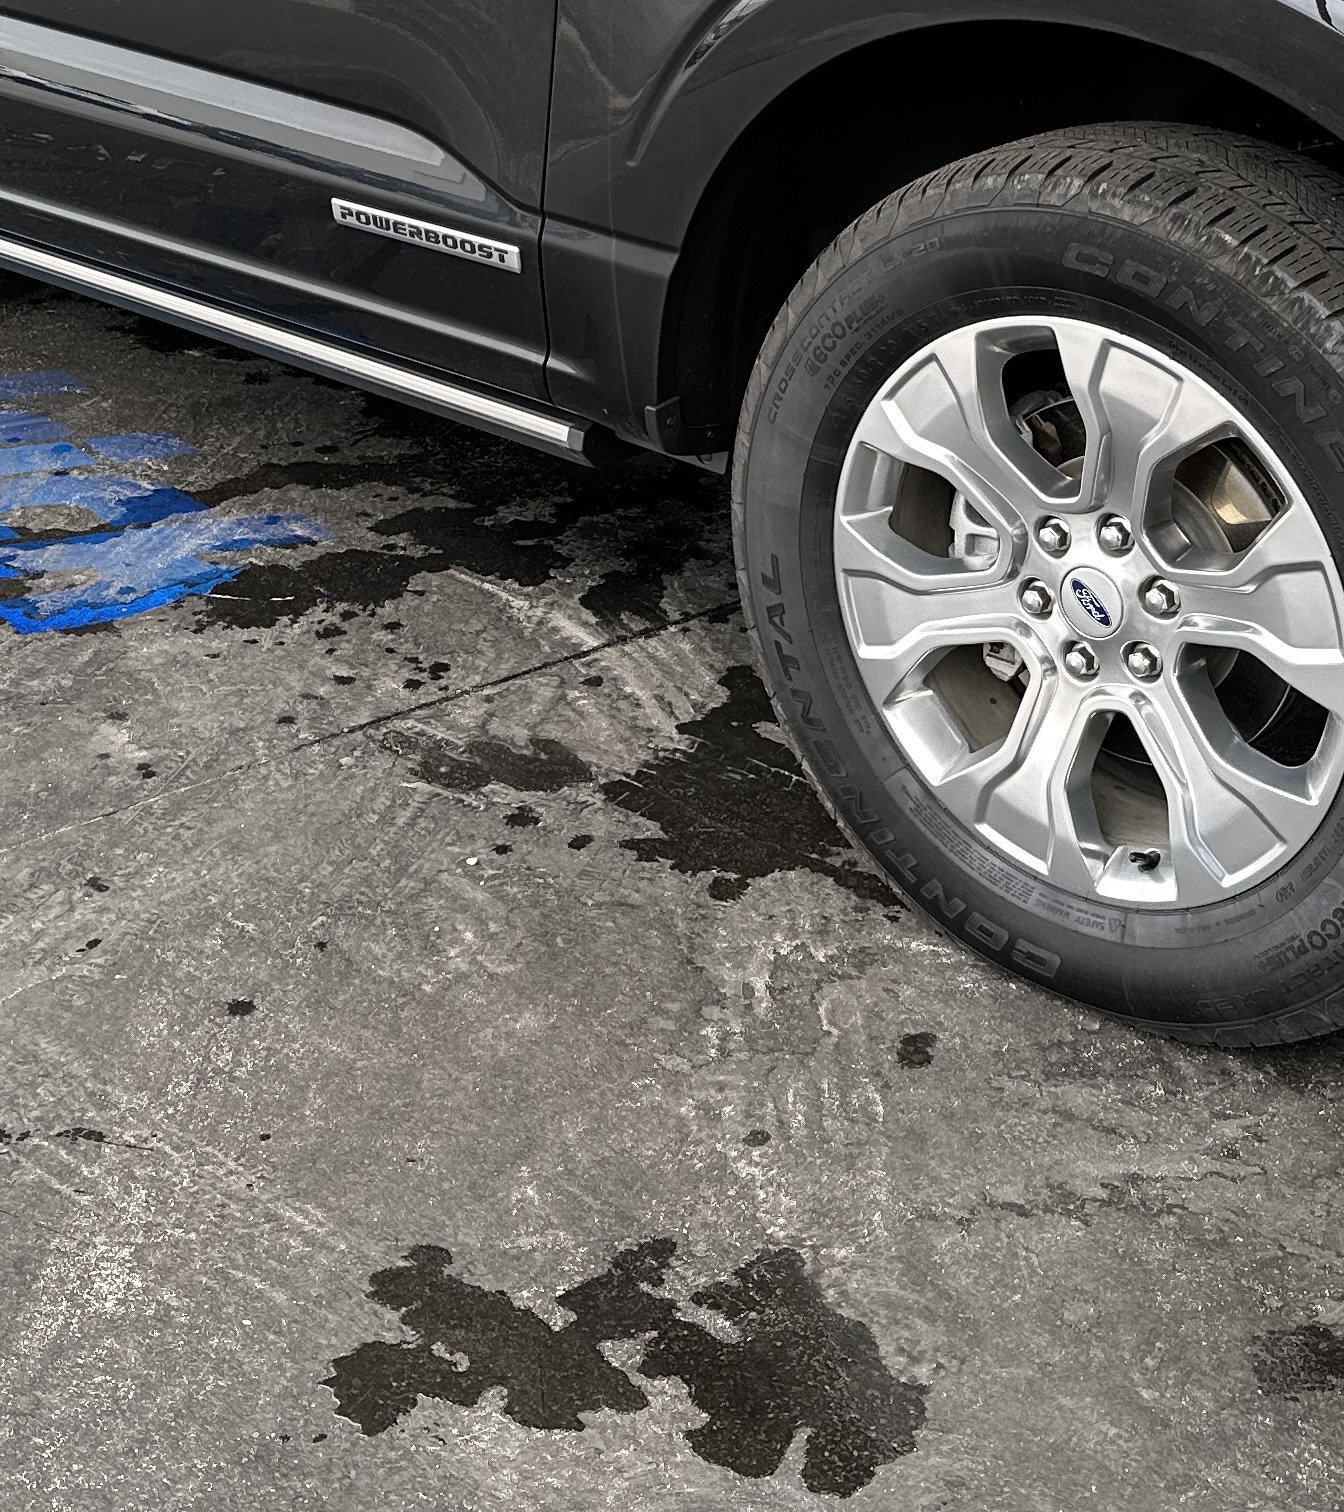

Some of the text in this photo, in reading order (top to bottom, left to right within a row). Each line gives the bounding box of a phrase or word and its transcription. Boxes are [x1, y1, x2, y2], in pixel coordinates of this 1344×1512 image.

[339, 206, 509, 264] POWERBOOST
[1075, 587, 1106, 621] Ford
[760, 553, 1062, 978] CONTINENTAL
